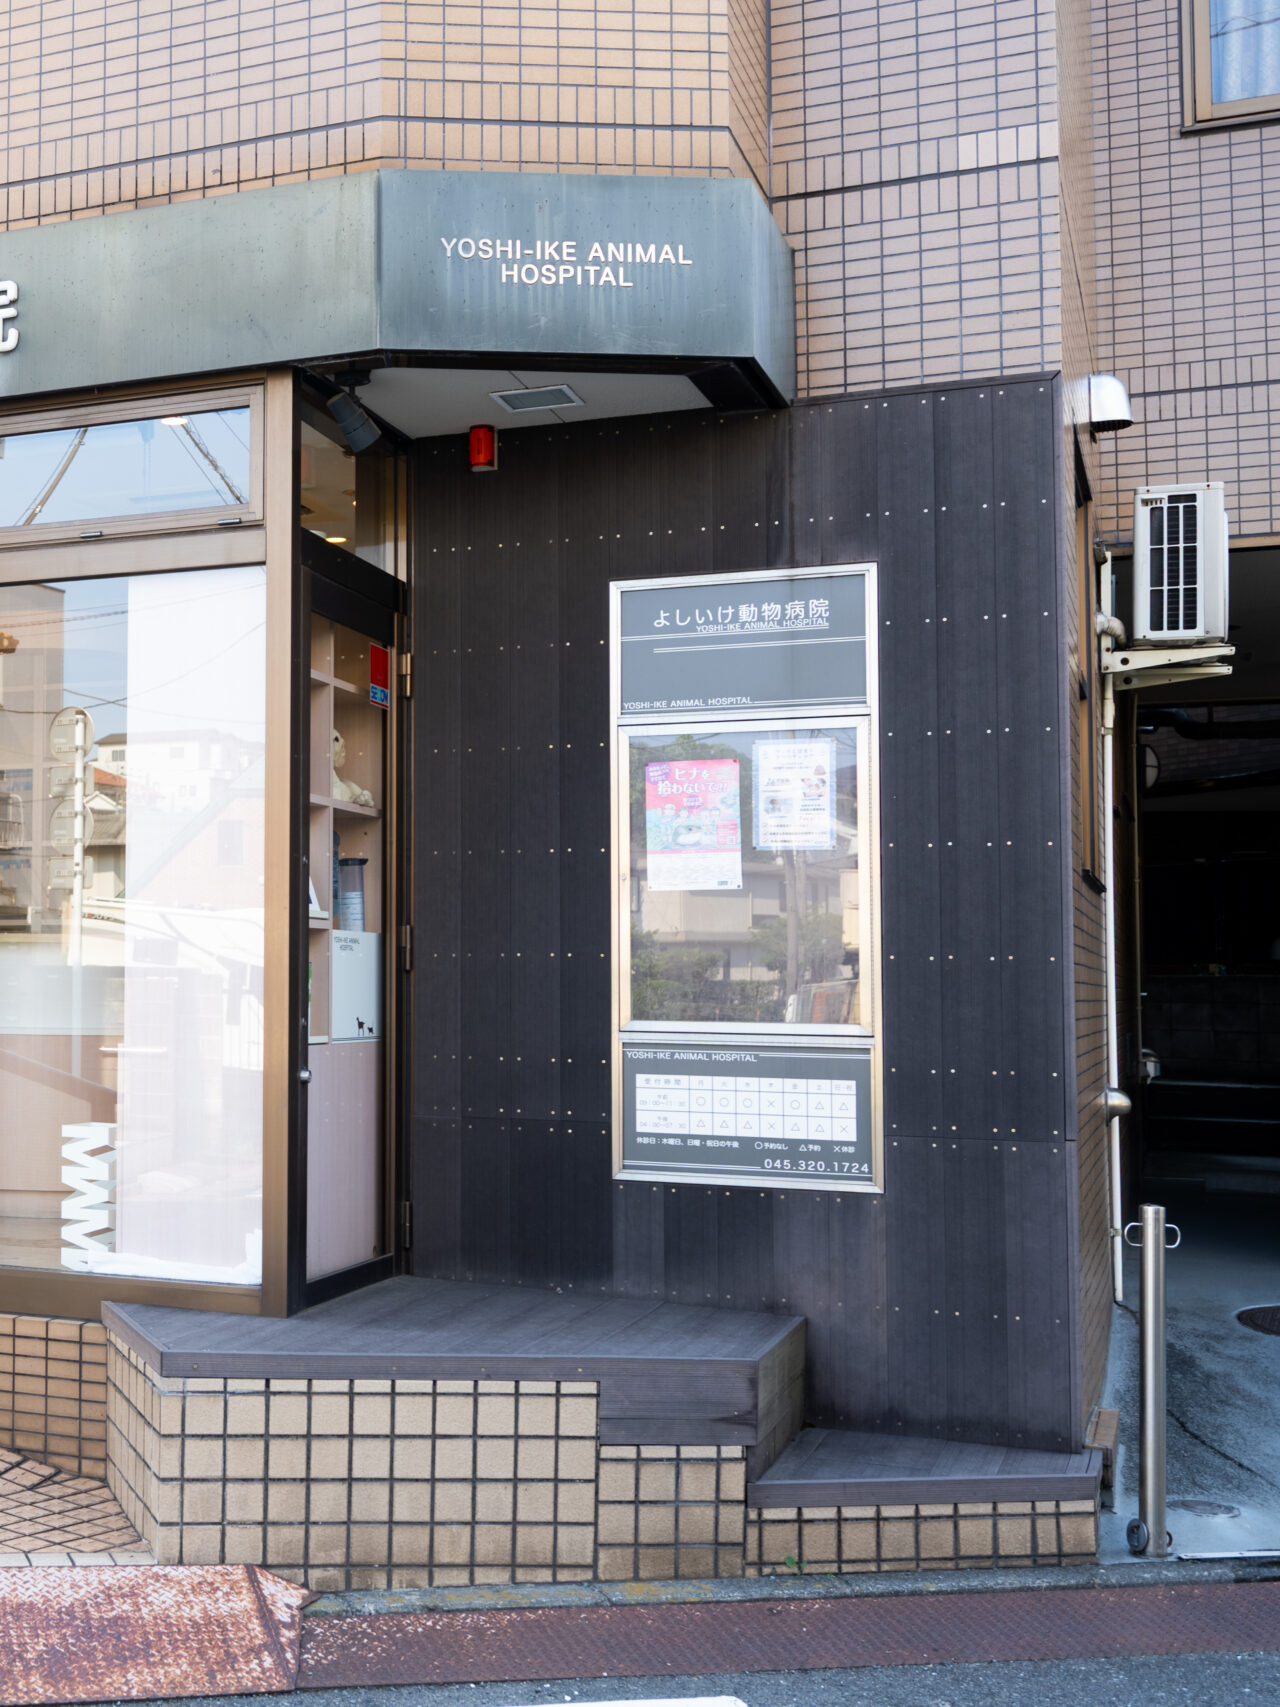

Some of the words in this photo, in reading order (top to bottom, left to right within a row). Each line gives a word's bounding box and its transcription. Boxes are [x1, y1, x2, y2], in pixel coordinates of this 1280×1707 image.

[440, 237, 577, 262] YOSHI-IKE
[587, 242, 693, 265] ANIMAL
[501, 263, 633, 287] HOSPITAL
[653, 598, 830, 628] よしいけ動物病院
[696, 623, 741, 633] YOSHI-IKE
[744, 620, 780, 631] ANIMAL
[783, 617, 829, 628] HOSPITAL
[623, 702, 668, 710] YOSHI-IKE
[671, 699, 705, 708] ANIMAL
[708, 696, 753, 706] HOSPITAL
[627, 1051, 671, 1060] YOSHI-IKE
[674, 1053, 709, 1061] ANIMAL
[712, 1054, 757, 1062] HOSPITAL
[764, 1158, 869, 1174] 045.320.1724
